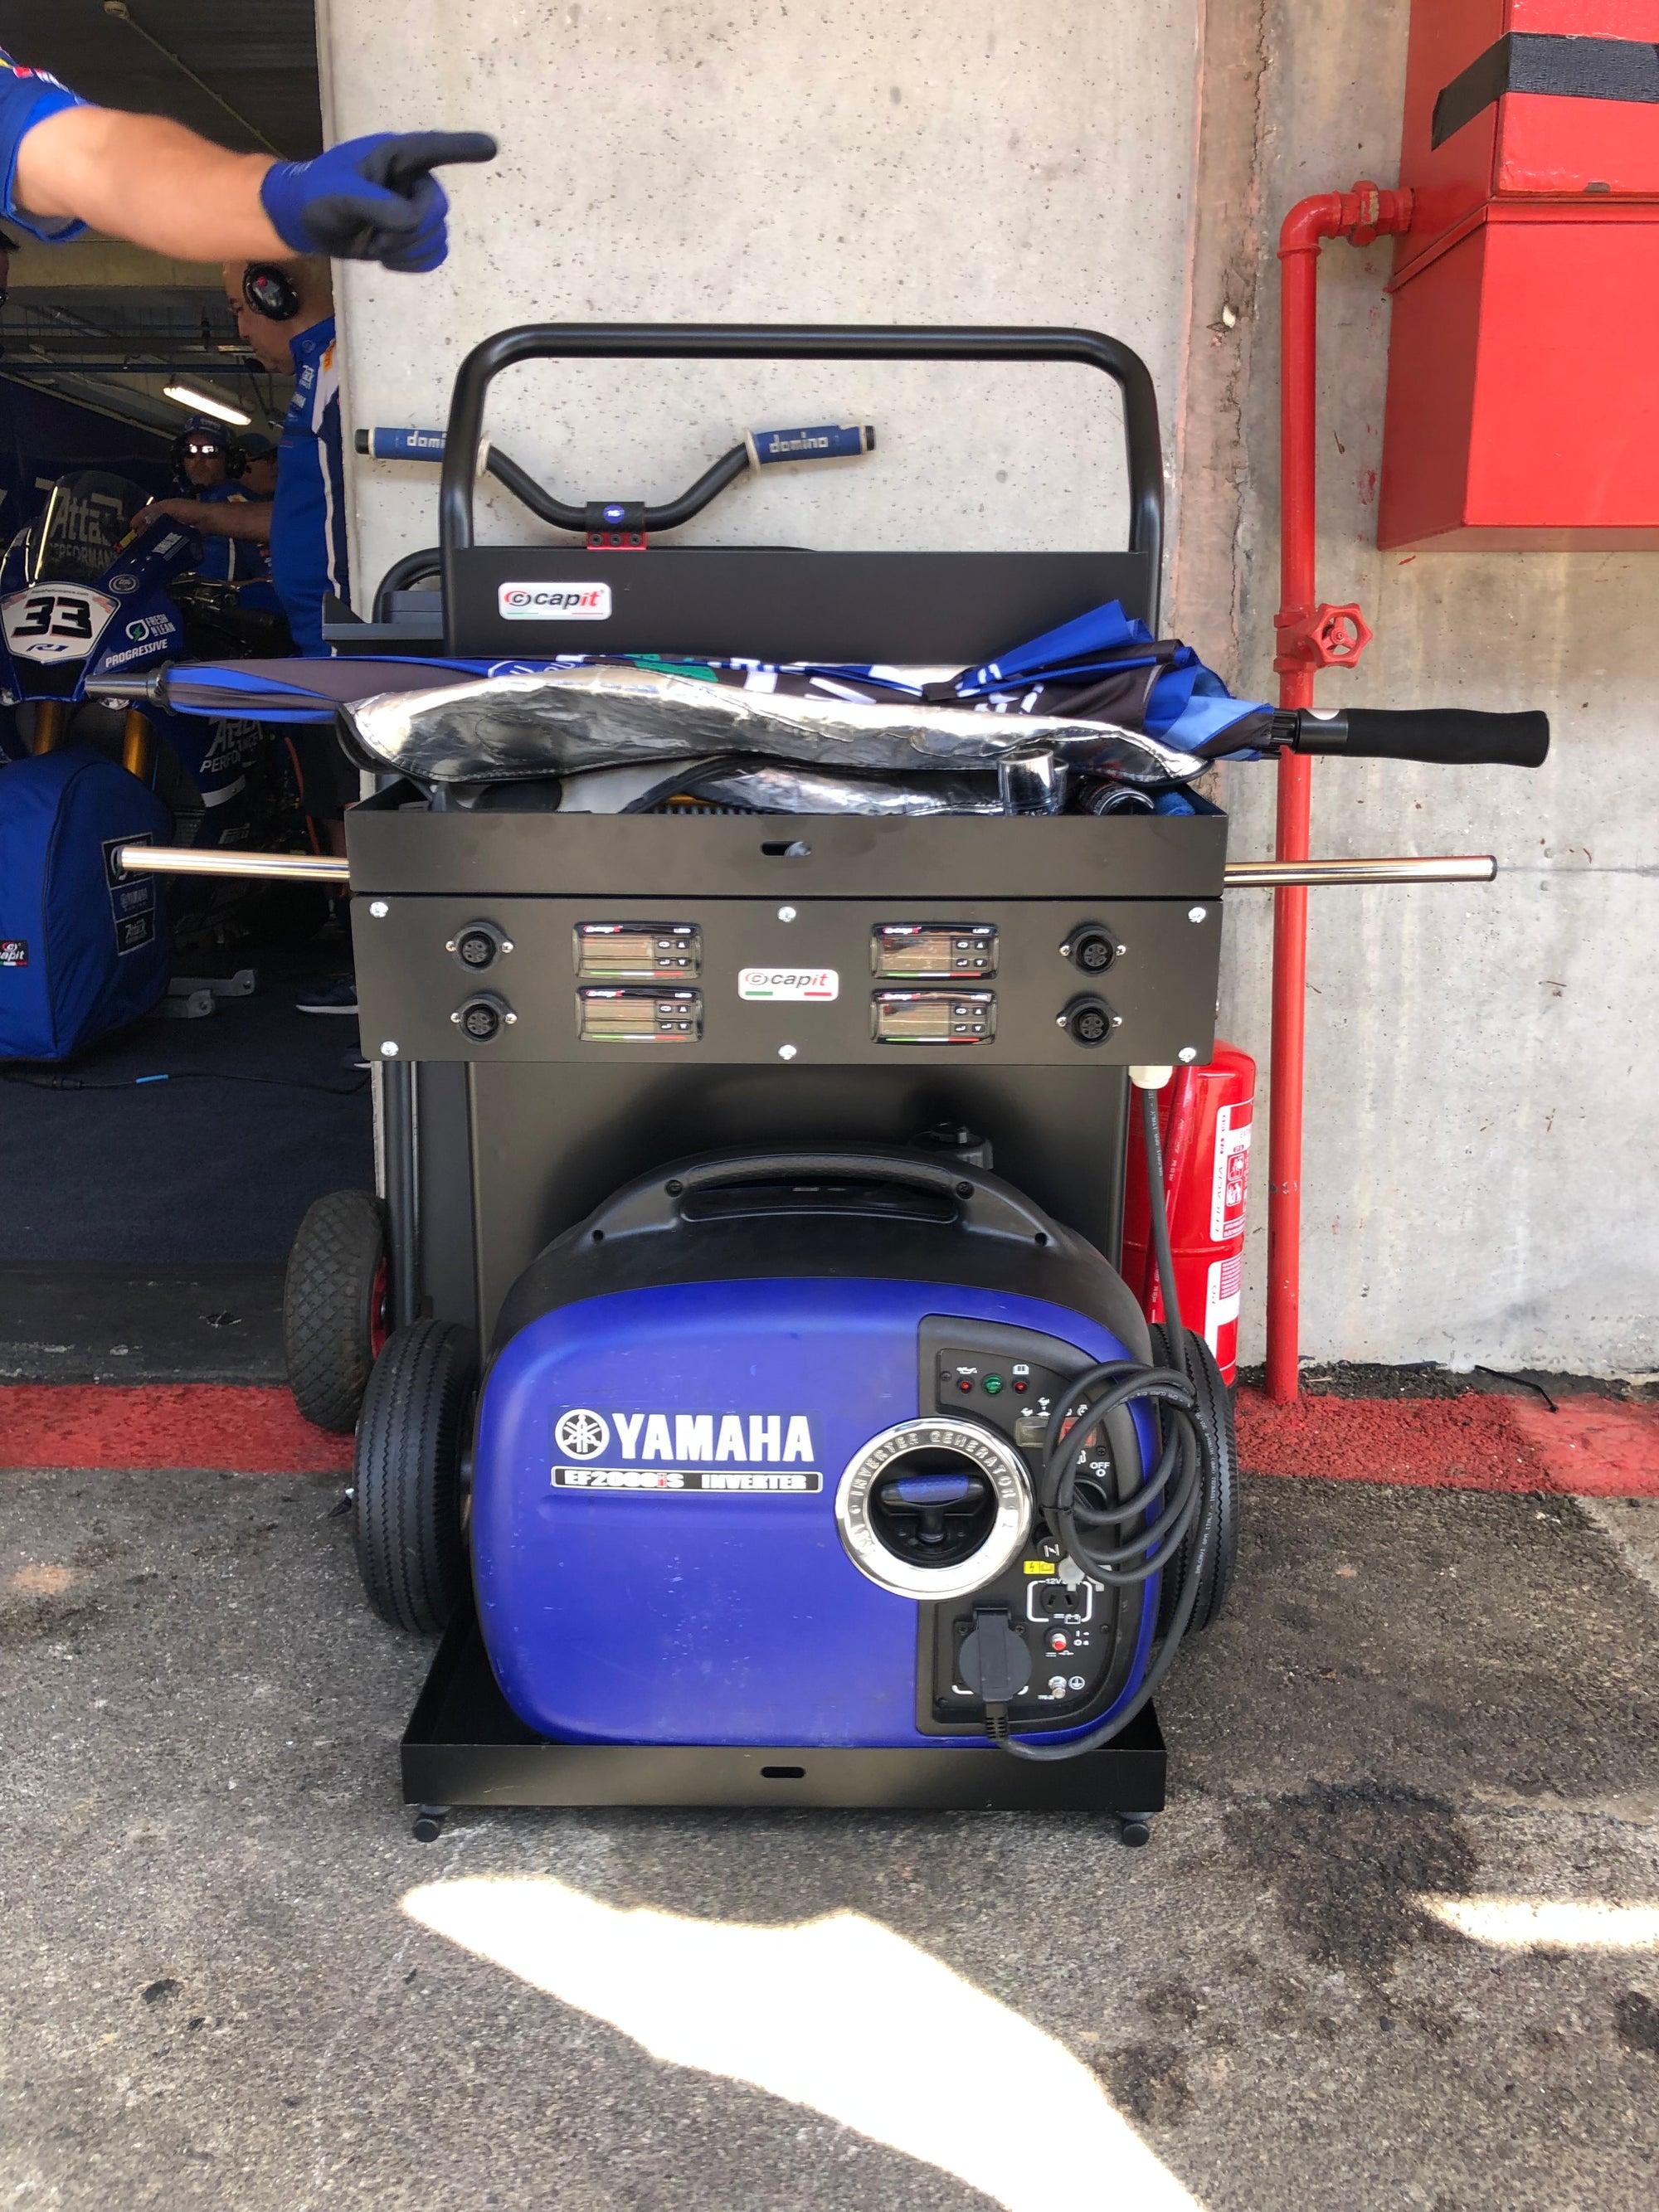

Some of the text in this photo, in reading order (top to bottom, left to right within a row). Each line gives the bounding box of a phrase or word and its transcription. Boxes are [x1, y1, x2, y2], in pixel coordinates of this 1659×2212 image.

[406, 430, 447, 449] domi
[769, 431, 829, 453] domino
[12, 596, 93, 639] 33
[105, 638, 168, 668] PROGRESSIVE
[611, 1412, 815, 1462] YAMAHA
[852, 1430, 1017, 1499] INVERTER GENERATOR
[1089, 1461, 1111, 1470] OFF
[564, 1470, 807, 1490] EF2000iS INVERTER
